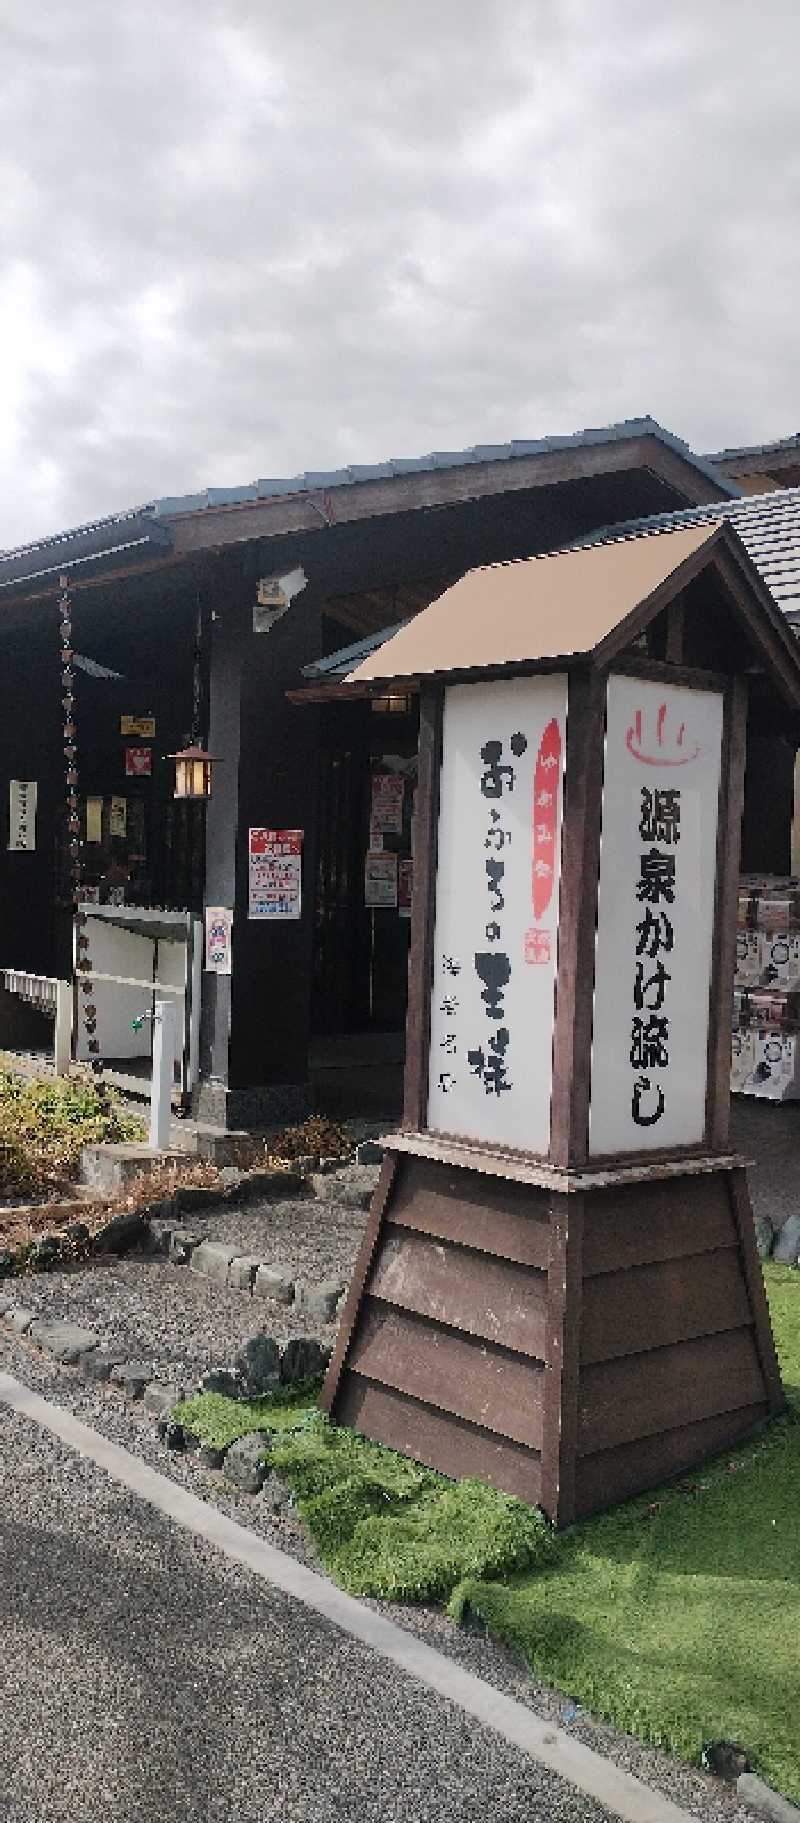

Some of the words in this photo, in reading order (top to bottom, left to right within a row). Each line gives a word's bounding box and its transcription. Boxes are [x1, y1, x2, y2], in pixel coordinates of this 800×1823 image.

[467, 731, 528, 1098] おふろの王様
[629, 786, 682, 1127] 源泉かけ流し
